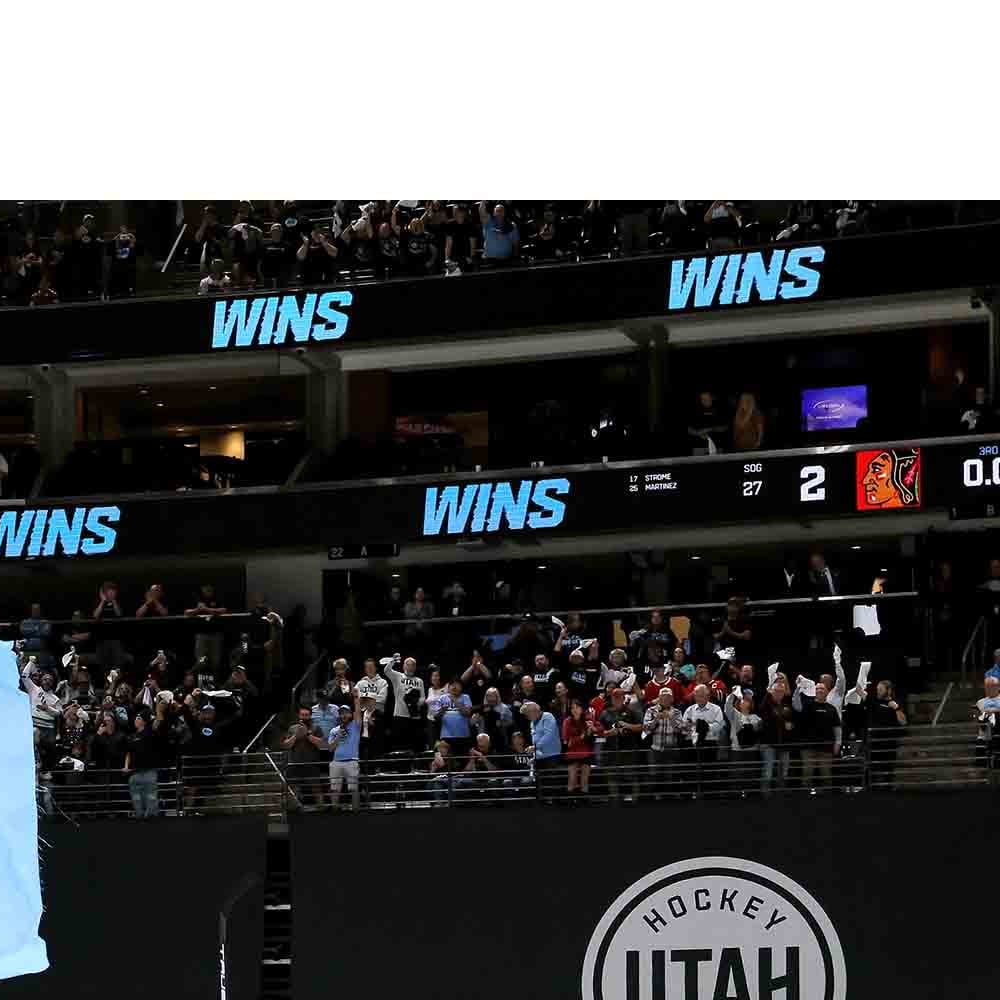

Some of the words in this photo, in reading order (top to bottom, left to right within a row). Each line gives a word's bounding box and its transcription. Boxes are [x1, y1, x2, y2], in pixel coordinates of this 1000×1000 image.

[669, 245, 825, 309] WINS
[212, 290, 352, 349] WINS
[645, 473, 672, 482] STROME
[744, 464, 762, 473] SOG
[800, 466, 826, 501] 2
[645, 482, 677, 491] MARTINEZ
[743, 481, 762, 496] 27
[424, 478, 570, 536] WINS
[642, 887, 787, 933] HOCKEY
